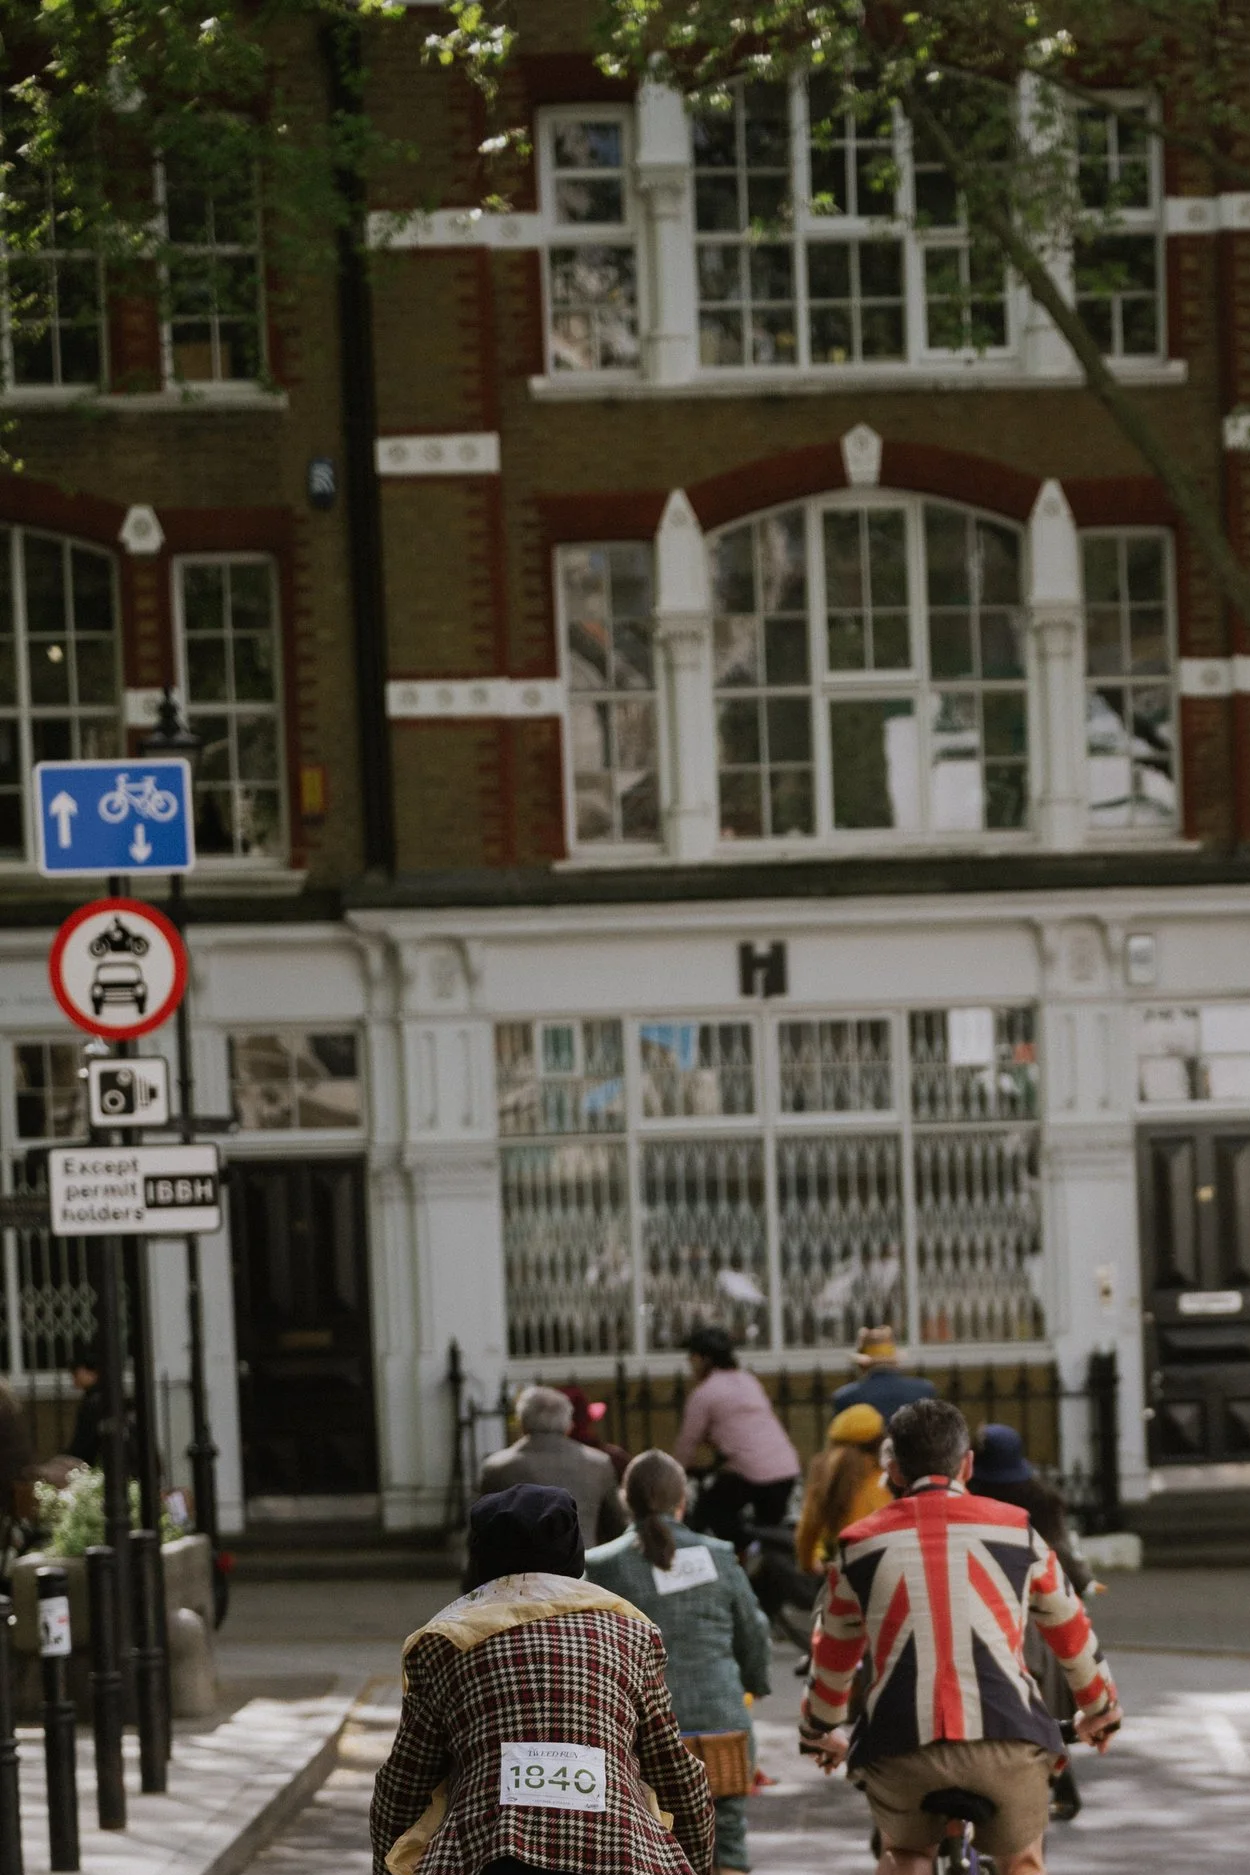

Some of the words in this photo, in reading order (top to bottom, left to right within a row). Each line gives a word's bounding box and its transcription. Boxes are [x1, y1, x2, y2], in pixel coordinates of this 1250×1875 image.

[63, 1157, 139, 1176] Except
[66, 1181, 137, 1201] permit
[61, 1203, 145, 1221] holders
[510, 1764, 597, 1794] 1840
